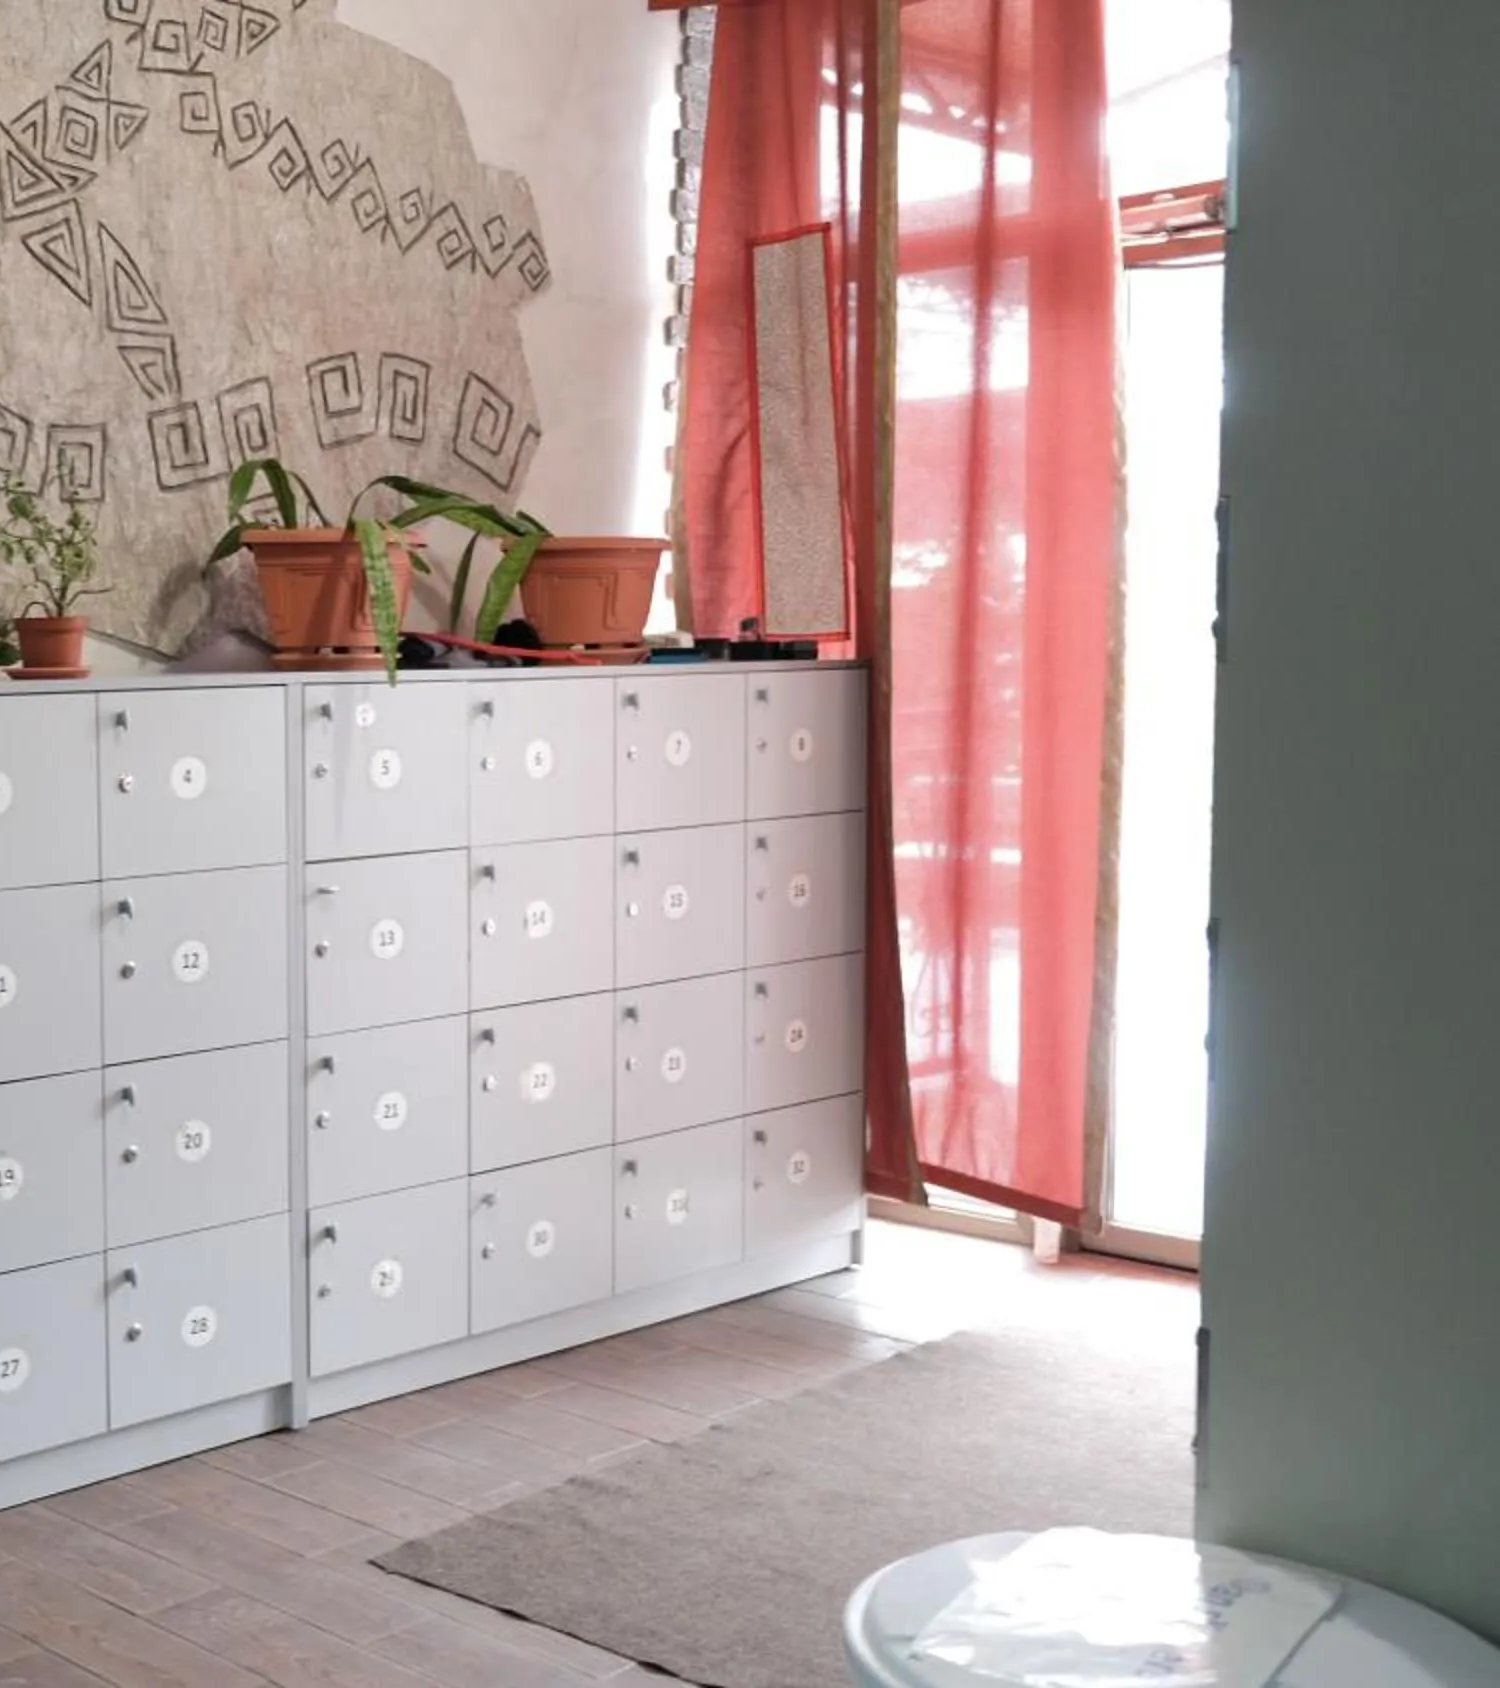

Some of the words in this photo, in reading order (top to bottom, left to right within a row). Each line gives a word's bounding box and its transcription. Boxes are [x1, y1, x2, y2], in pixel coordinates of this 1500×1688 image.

[379, 930, 395, 947] 13
[183, 952, 200, 969] 12
[383, 1103, 399, 1119] 21
[184, 1133, 201, 1150] 20
[190, 1317, 208, 1335] 28
[1, 1359, 20, 1378] 27
